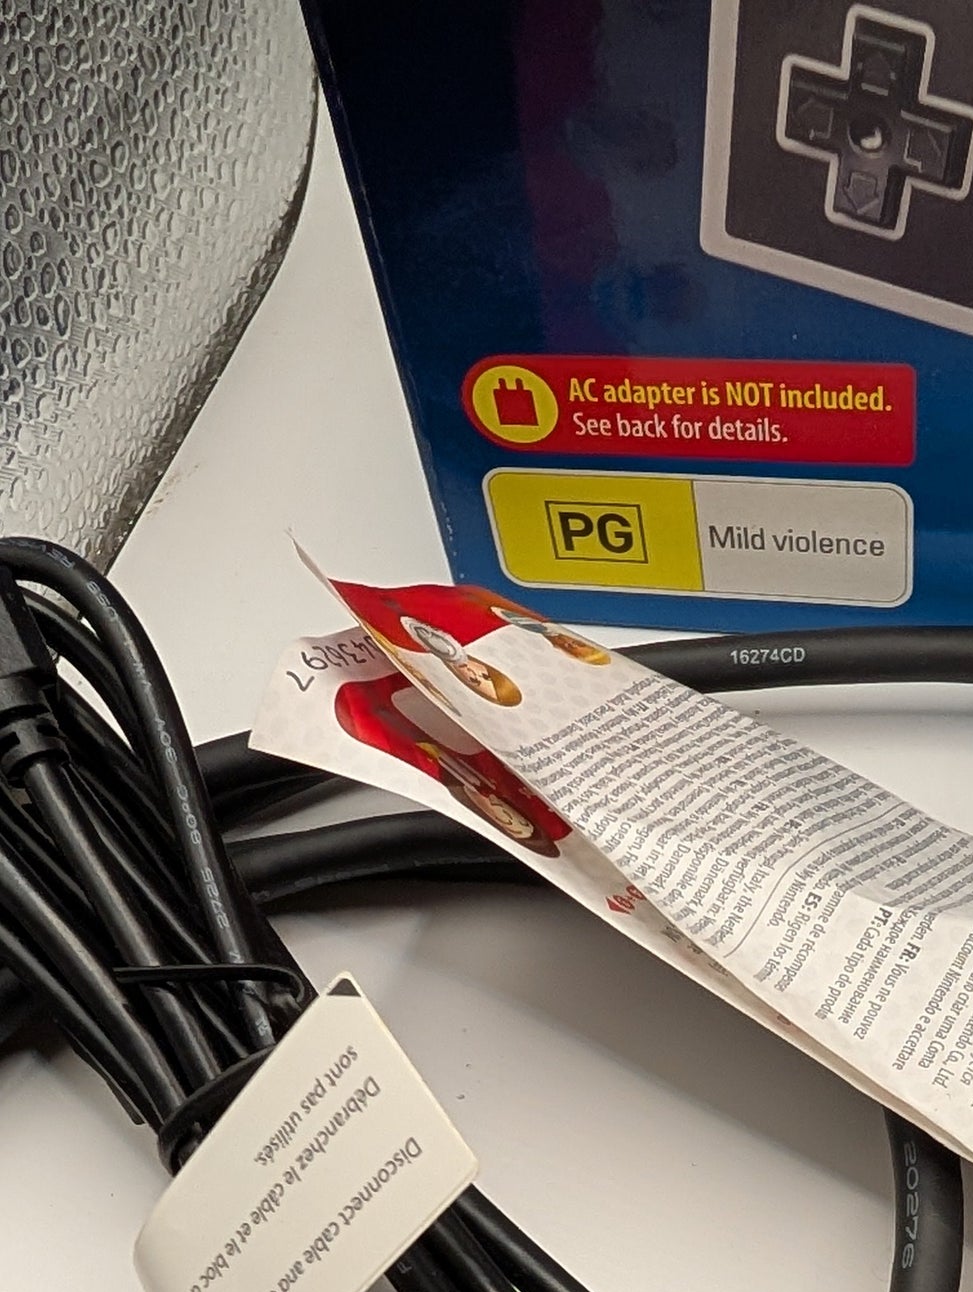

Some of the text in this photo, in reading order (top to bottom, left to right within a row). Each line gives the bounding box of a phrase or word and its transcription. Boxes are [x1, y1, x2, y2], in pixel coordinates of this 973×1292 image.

[569, 379, 892, 411] AC adapter is NOT included.
[573, 414, 788, 443] See back for details.
[558, 511, 633, 553] PG
[709, 525, 885, 556] Mild violence
[730, 647, 806, 665] 16274CD
[716, 852, 750, 904] verfügbar
[733, 869, 770, 913] Italy, the
[767, 879, 806, 926] Nintendo.
[774, 892, 822, 959] ES: Rigen los
[810, 924, 825, 938] de
[835, 908, 892, 988] PT: Cada tipo de
[838, 944, 892, 1024] наименование
[854, 942, 920, 1040] FR: Vous ne pouvez
[925, 968, 961, 1015] Nintendo
[950, 992, 969, 1016] criar
[919, 1016, 930, 1024] e
[935, 1016, 956, 1039] uma
[892, 1024, 926, 1070] accettare
[918, 1041, 944, 1068] Conta
[942, 1051, 964, 1065] Co.,
[932, 1068, 954, 1088] Ltd.
[254, 1046, 357, 1165] sont pas utilisés.
[296, 1076, 380, 1170] Débranchez
[283, 1166, 301, 1184] le
[338, 1137, 422, 1225] Disconnect
[250, 1183, 284, 1224] câble
[901, 1141, 920, 1269] 20276
[225, 1238, 241, 1256] le
[236, 1223, 251, 1243] et
[303, 1222, 339, 1264] cable
[200, 1254, 229, 1288] bloc
